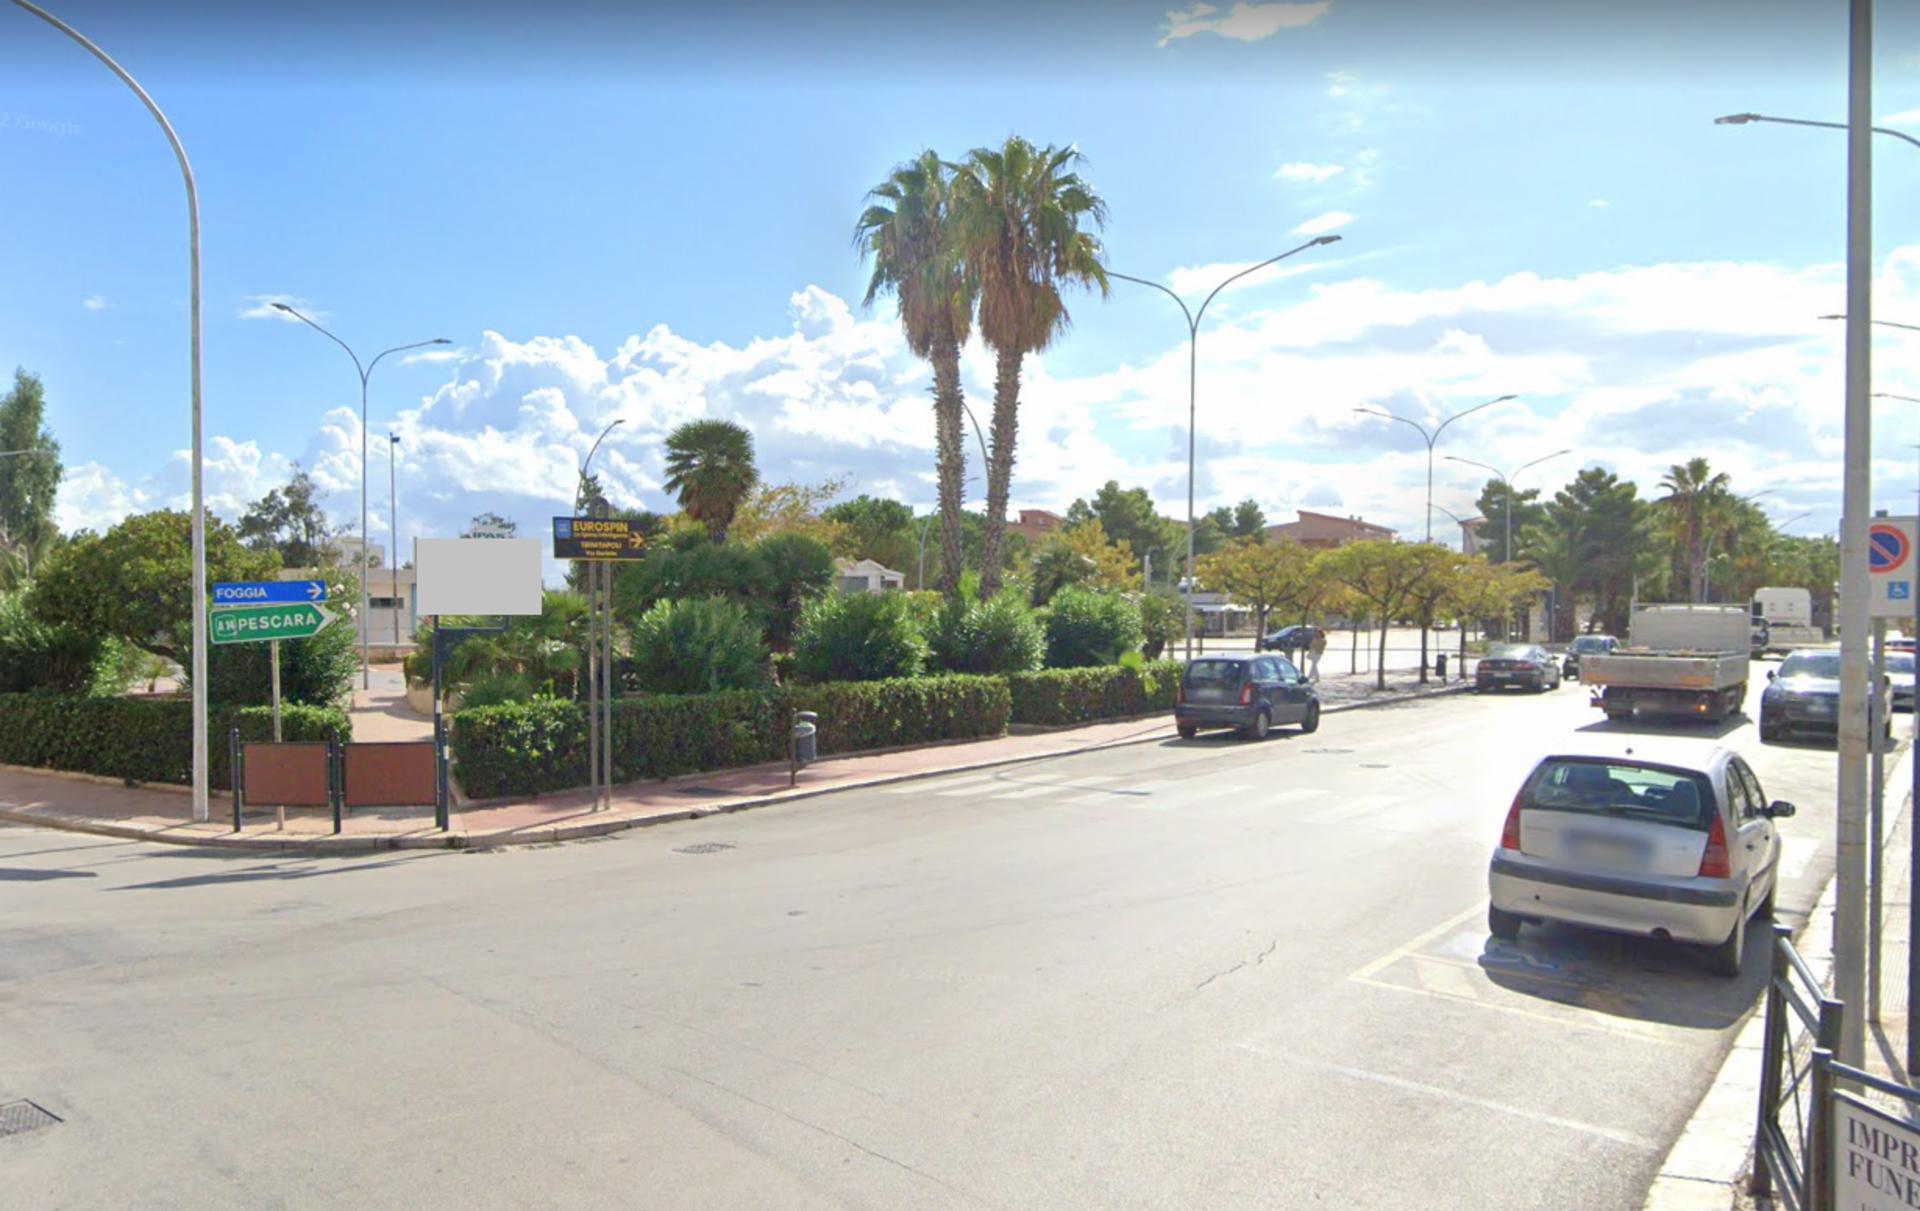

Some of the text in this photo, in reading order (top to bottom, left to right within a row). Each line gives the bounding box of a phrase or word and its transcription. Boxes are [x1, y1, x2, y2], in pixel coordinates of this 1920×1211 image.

[573, 521, 629, 532] EUROSPIN
[216, 586, 268, 599] FOGGIA
[238, 612, 317, 631] PESCARA
[1848, 1117, 1920, 1174] IMPR
